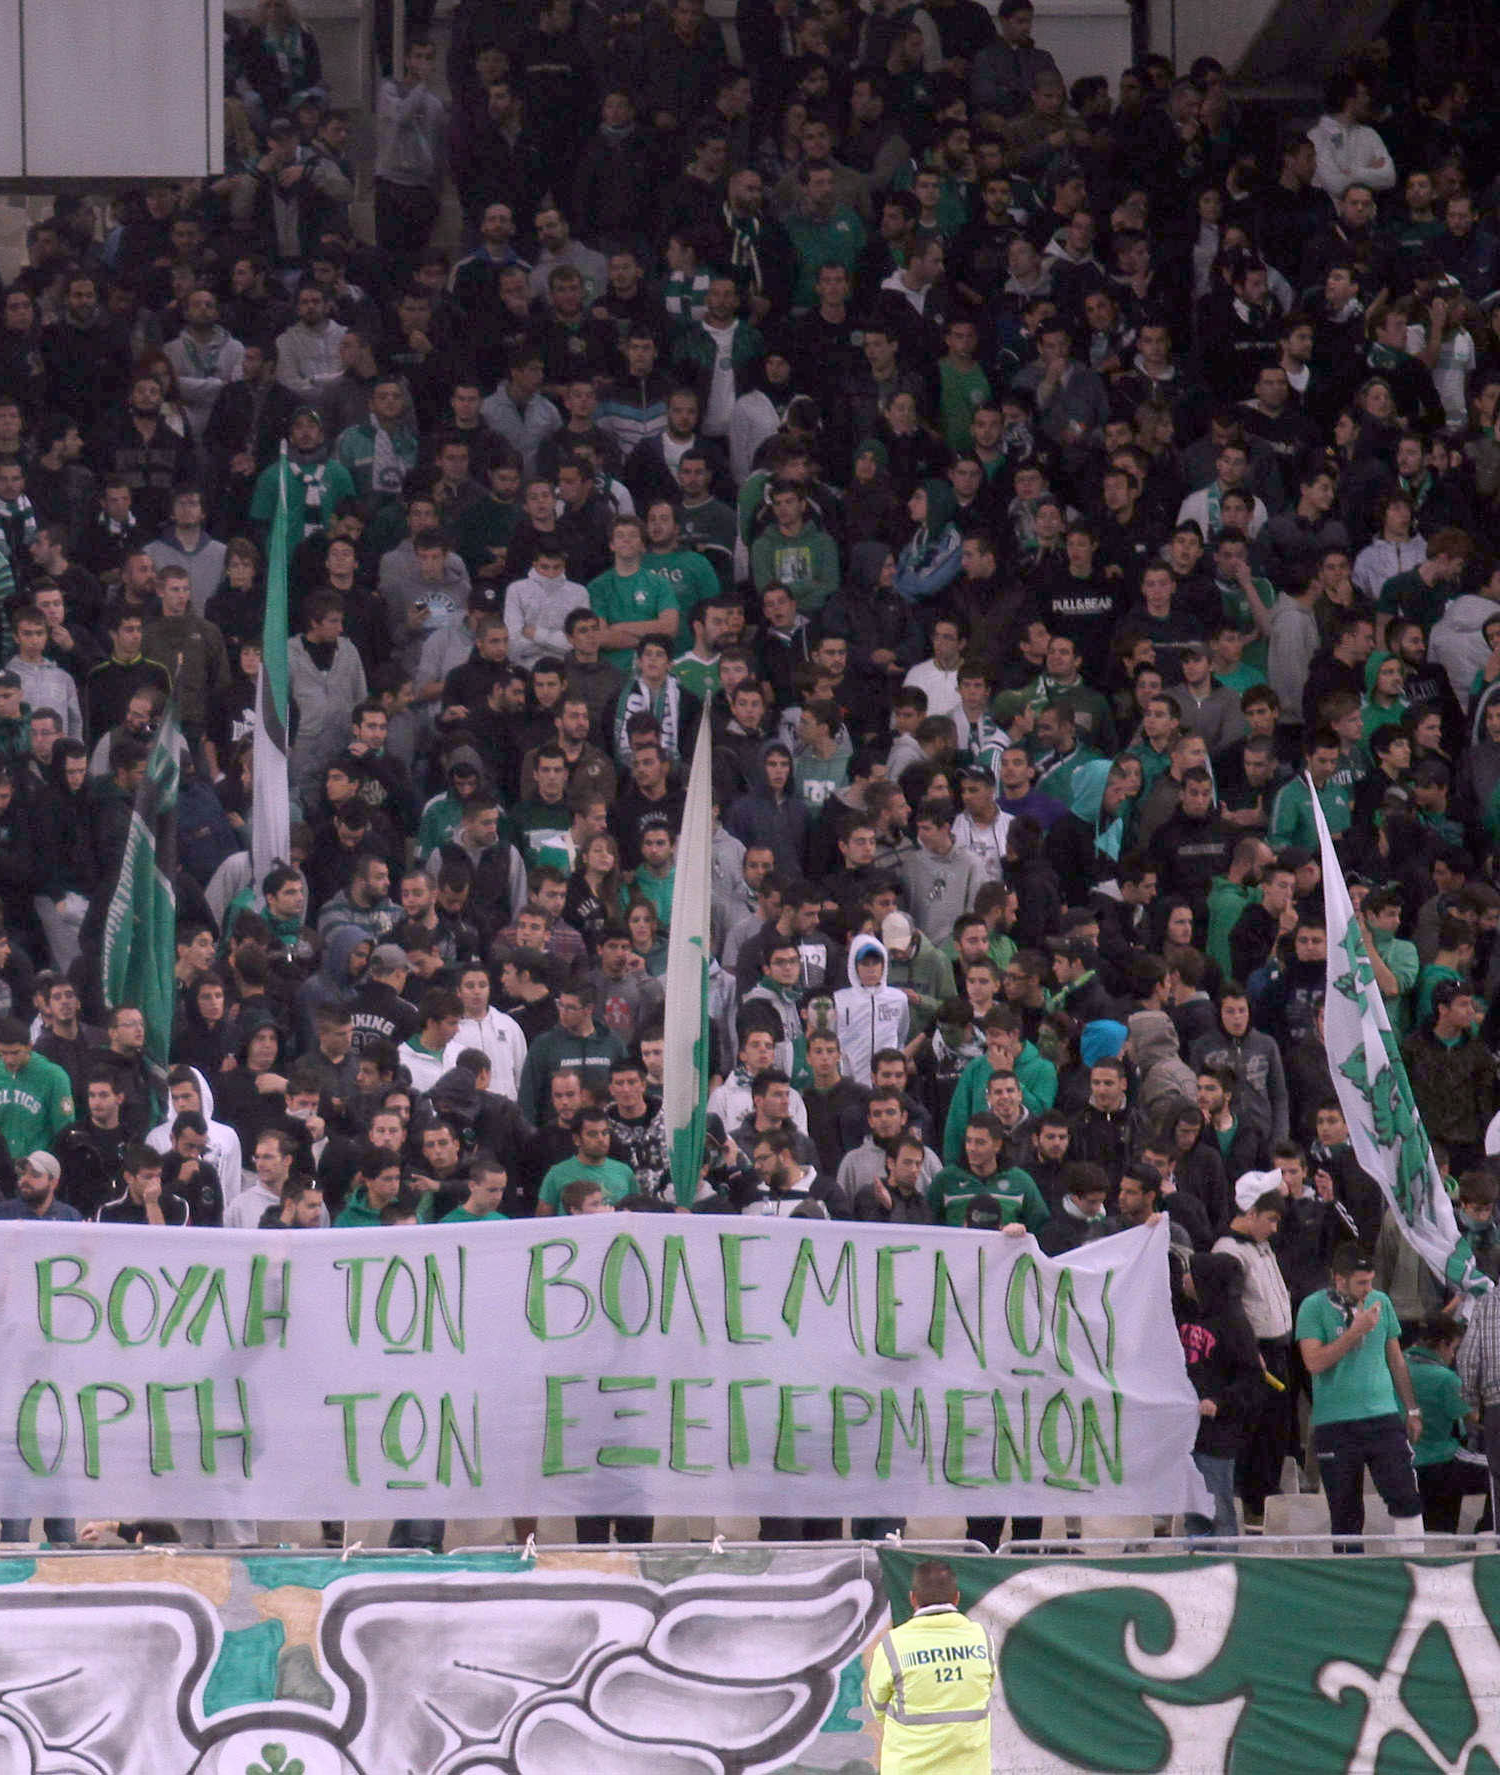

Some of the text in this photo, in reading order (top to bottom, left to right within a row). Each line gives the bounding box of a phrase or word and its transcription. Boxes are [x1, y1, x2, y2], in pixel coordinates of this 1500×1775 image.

[350, 1013, 396, 1036] IKING
[35, 1254, 292, 1349] ΒΟΥΛΗ
[17, 1378, 255, 1480] ΟΡΓΗ
[916, 1644, 987, 1665] BRINKS
[934, 1666, 964, 1683] 121
